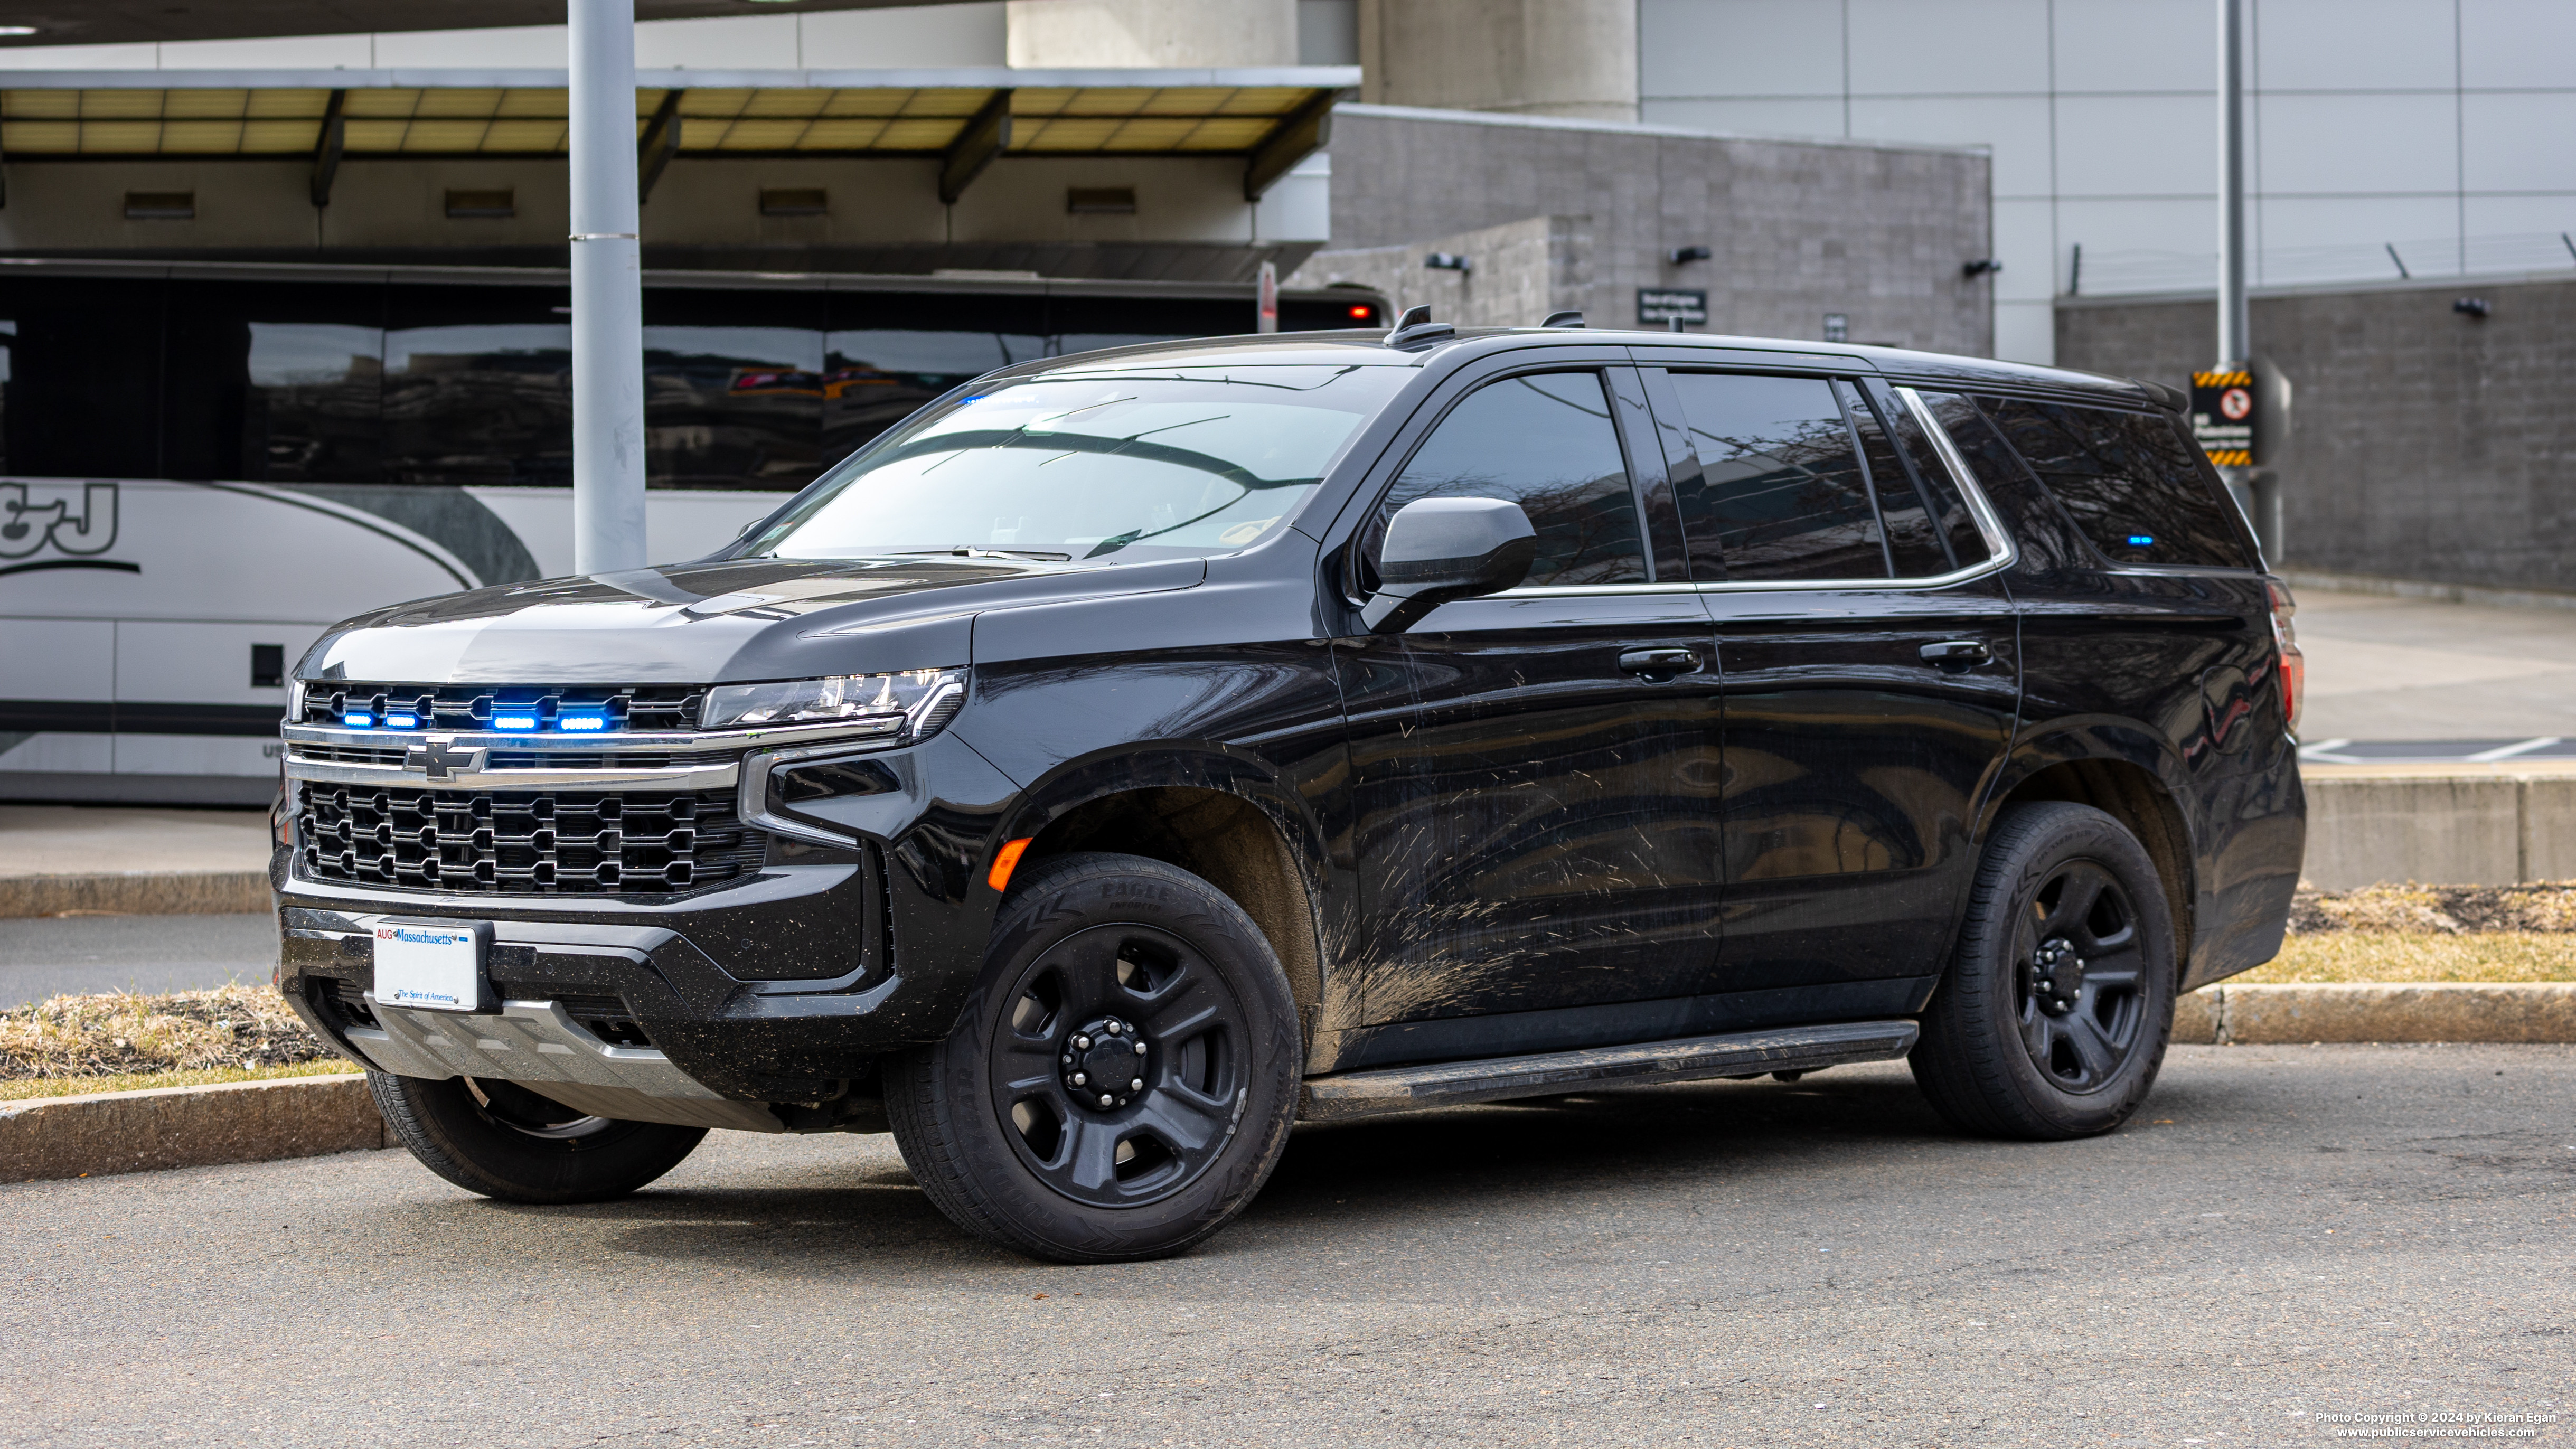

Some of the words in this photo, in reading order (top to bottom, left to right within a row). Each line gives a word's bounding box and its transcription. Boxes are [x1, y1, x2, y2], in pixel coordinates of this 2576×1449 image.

[1101, 882, 1172, 902] EAGLE
[377, 929, 392, 939] AUG
[397, 929, 452, 945] Massachusetts
[409, 991, 423, 1000] Spirit
[424, 992, 430, 1001] of
[957, 1067, 1059, 1231] GOODYEAR
